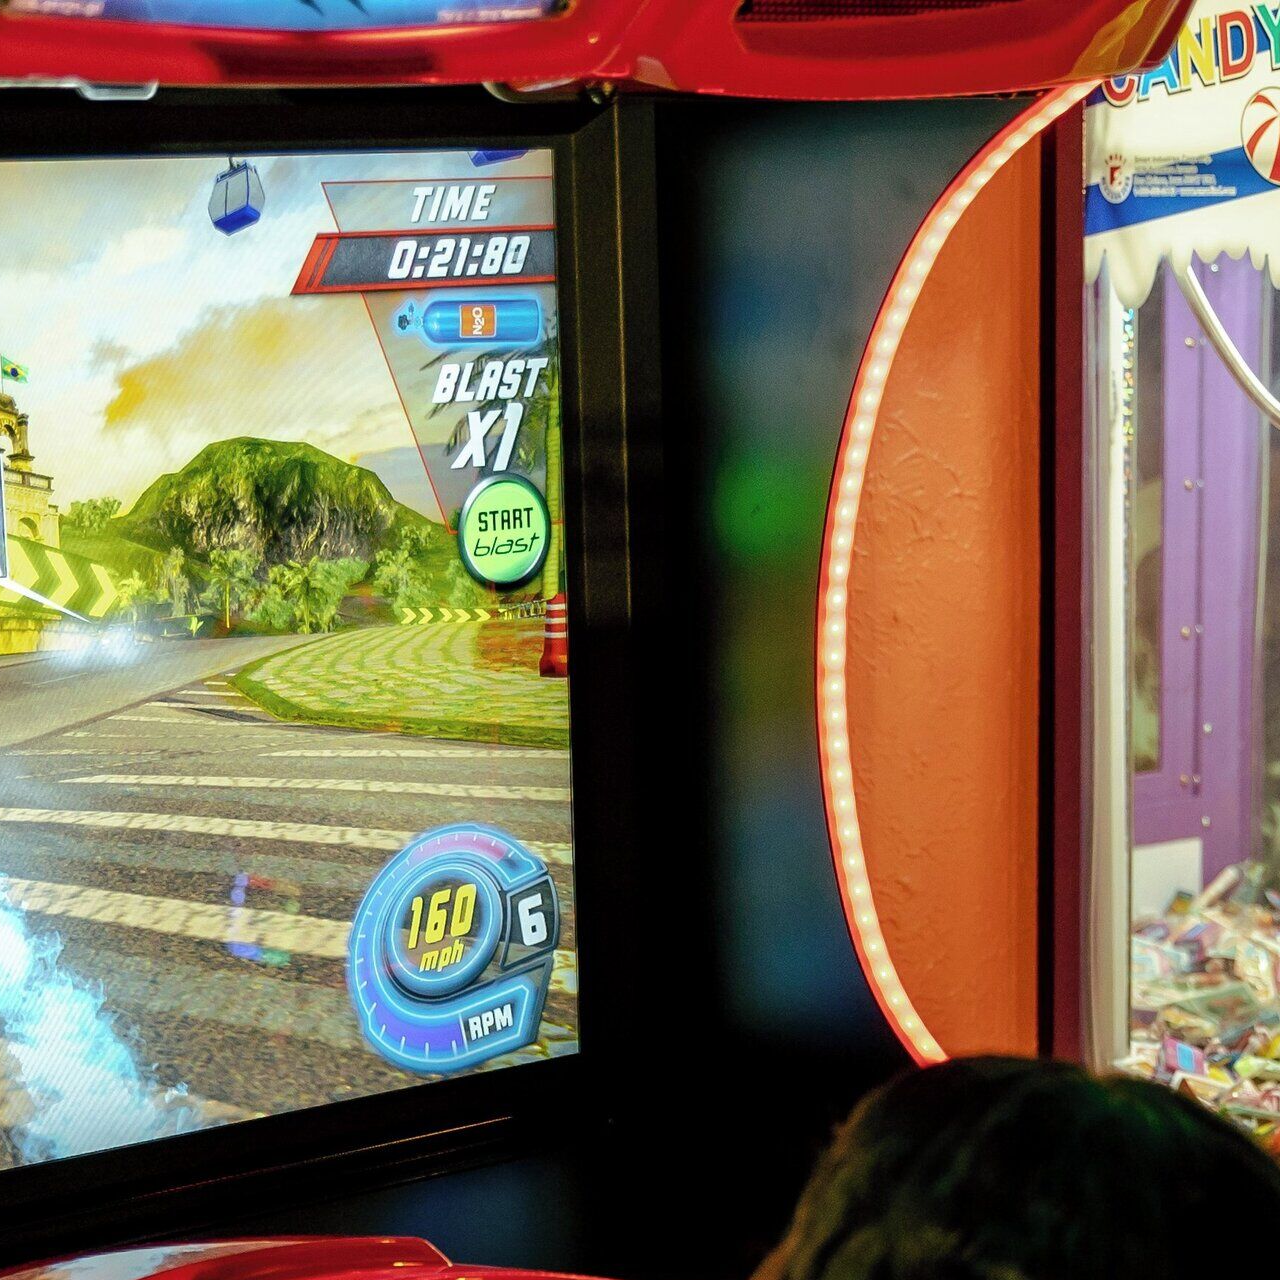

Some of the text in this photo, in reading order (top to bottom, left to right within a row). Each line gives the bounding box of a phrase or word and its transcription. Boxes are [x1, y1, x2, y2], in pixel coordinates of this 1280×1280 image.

[410, 184, 496, 223] TIME
[472, 307, 485, 335] N2O
[432, 358, 549, 404] BLAST
[478, 507, 534, 532] START
[473, 534, 540, 557] blast
[408, 884, 477, 949] 160
[518, 893, 548, 946] 6
[419, 939, 464, 972] mph
[468, 1003, 513, 1042] RPM
